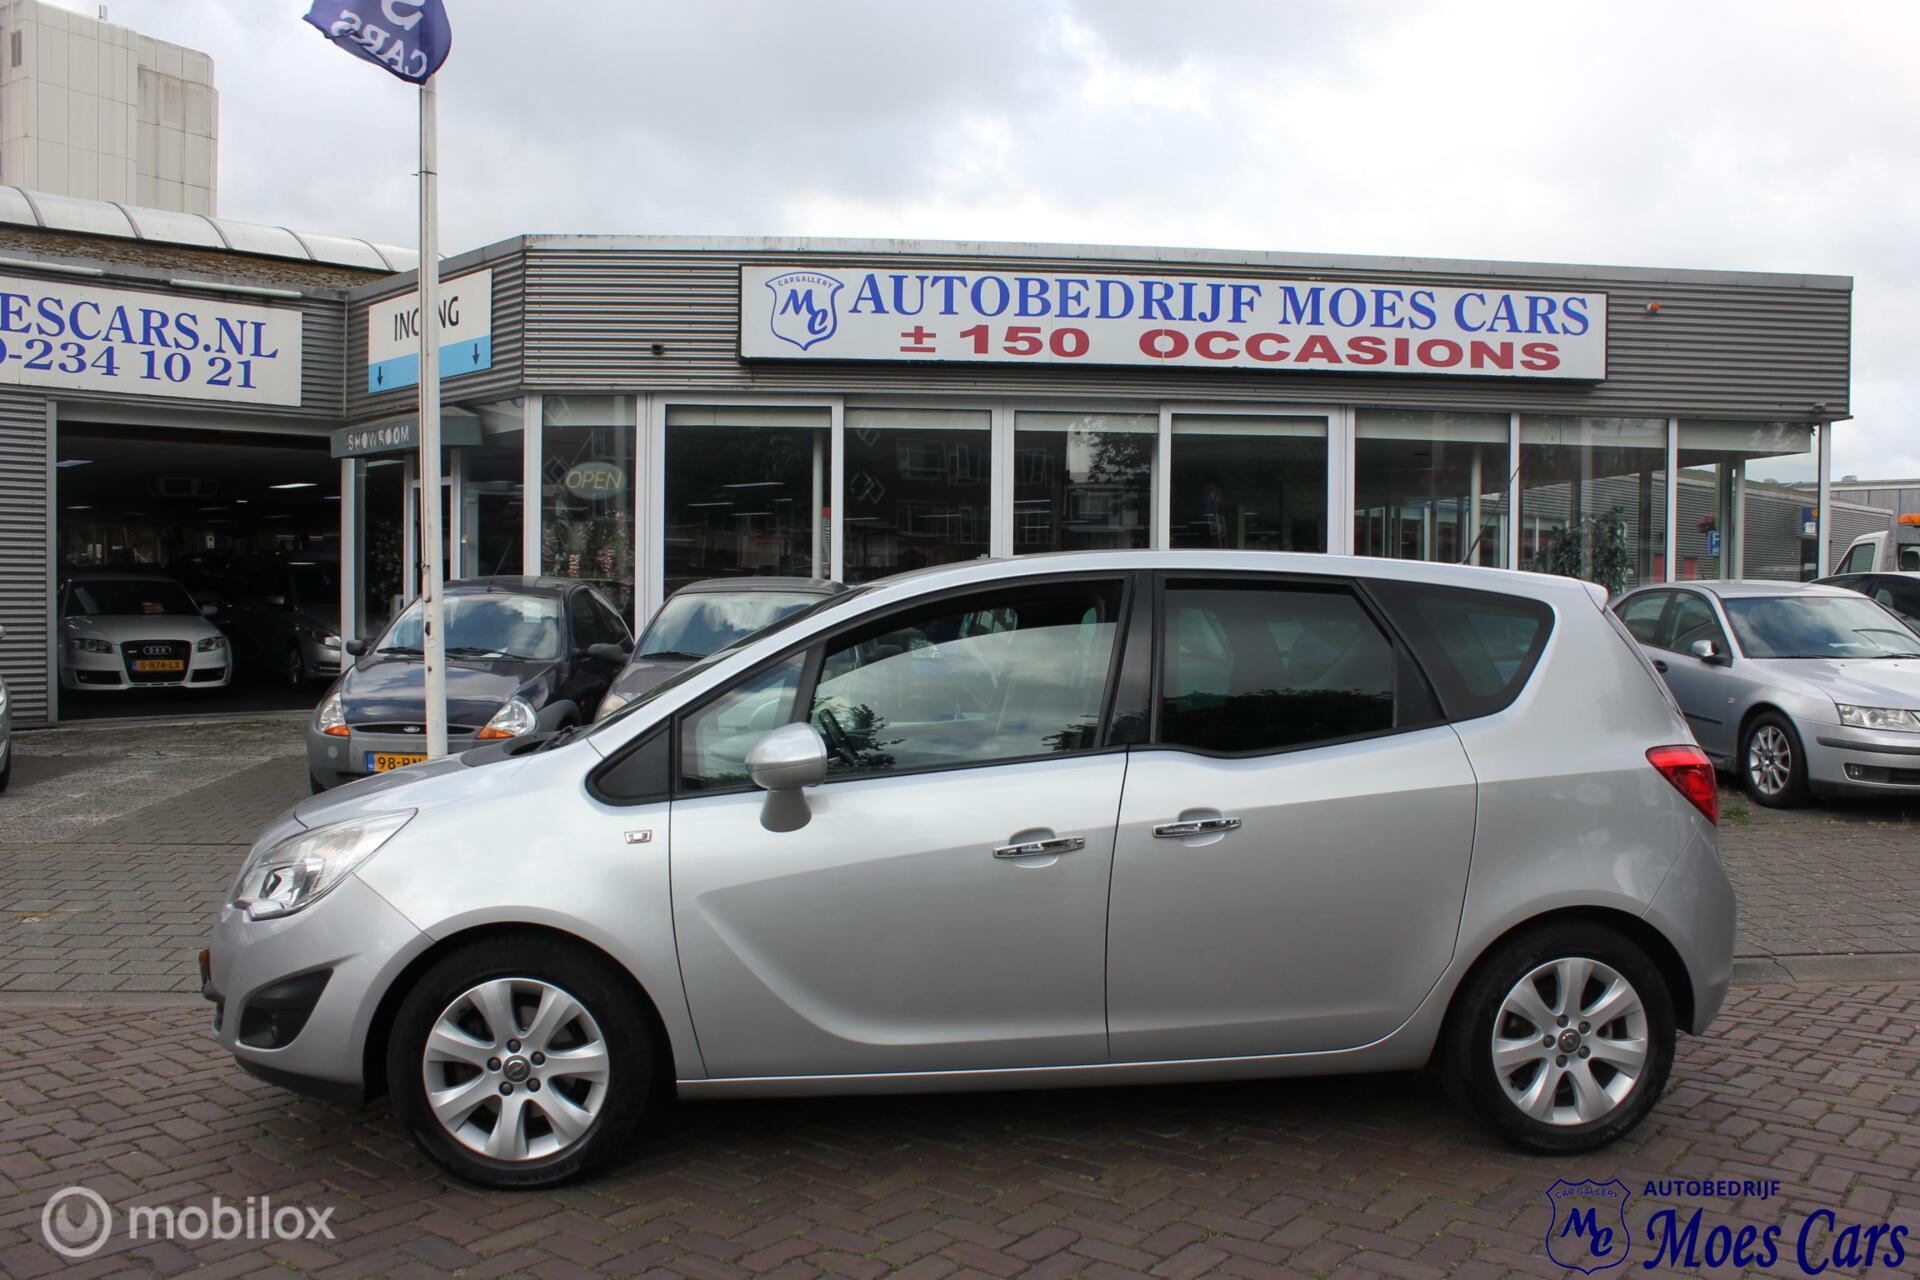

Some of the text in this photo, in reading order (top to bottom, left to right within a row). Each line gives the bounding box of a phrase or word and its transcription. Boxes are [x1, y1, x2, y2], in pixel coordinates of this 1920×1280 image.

[778, 275, 833, 288] CARGALLERY
[848, 272, 1591, 337] AUTOBEDRIJF MOES CARS
[394, 295, 460, 342] INGNG
[0, 337, 256, 389] -234 10 21
[960, 324, 1090, 358] 150
[1139, 329, 1560, 371] OCCASIONS
[347, 424, 410, 451] SHOWROOM
[565, 470, 623, 490] OPEN
